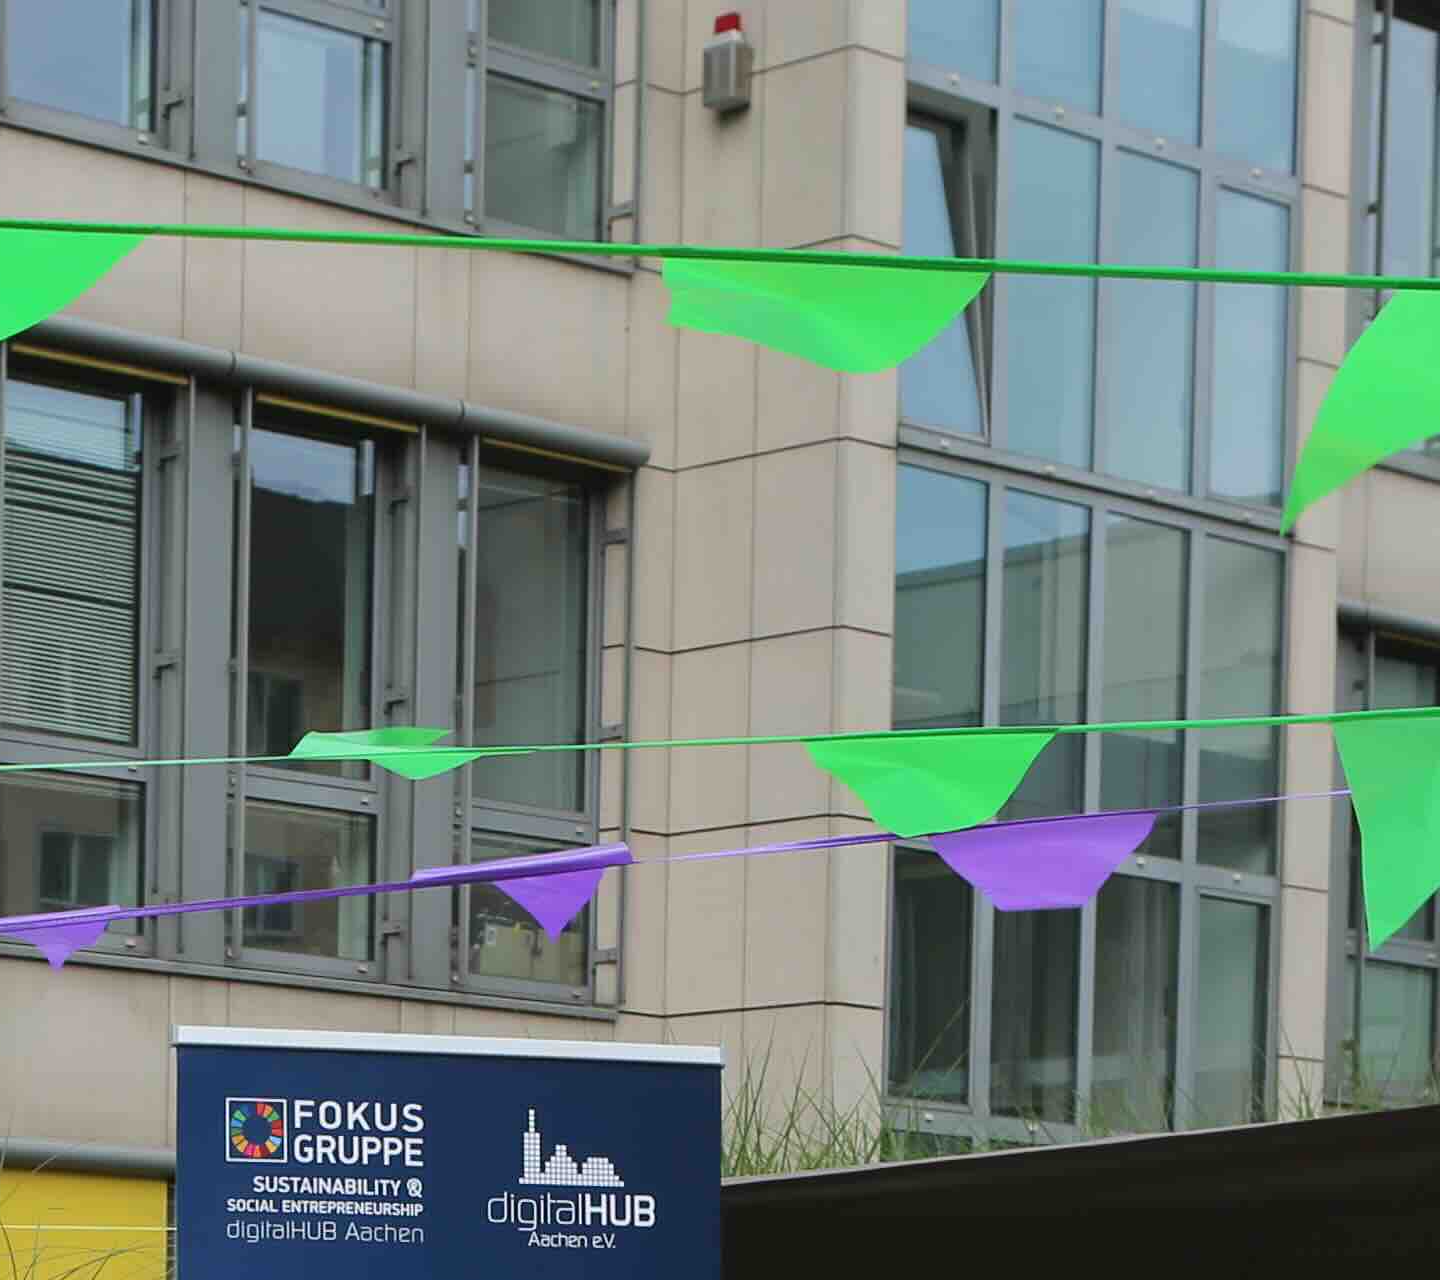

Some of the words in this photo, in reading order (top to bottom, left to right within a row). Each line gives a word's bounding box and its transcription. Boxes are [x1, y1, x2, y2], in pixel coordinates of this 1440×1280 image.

[293, 1100, 425, 1132] FOKUS
[293, 1135, 425, 1168] GRUPPE
[252, 1175, 402, 1198] SUSTAINABILITY
[406, 1178, 424, 1198] &
[226, 1198, 279, 1214] SOCIAL
[281, 1199, 424, 1217] ENTREPRENEURSHIP
[486, 1191, 657, 1232] digitalHUB
[226, 1219, 337, 1244] digitalHUB
[344, 1222, 424, 1244] Aachen
[528, 1230, 589, 1249] Aachen
